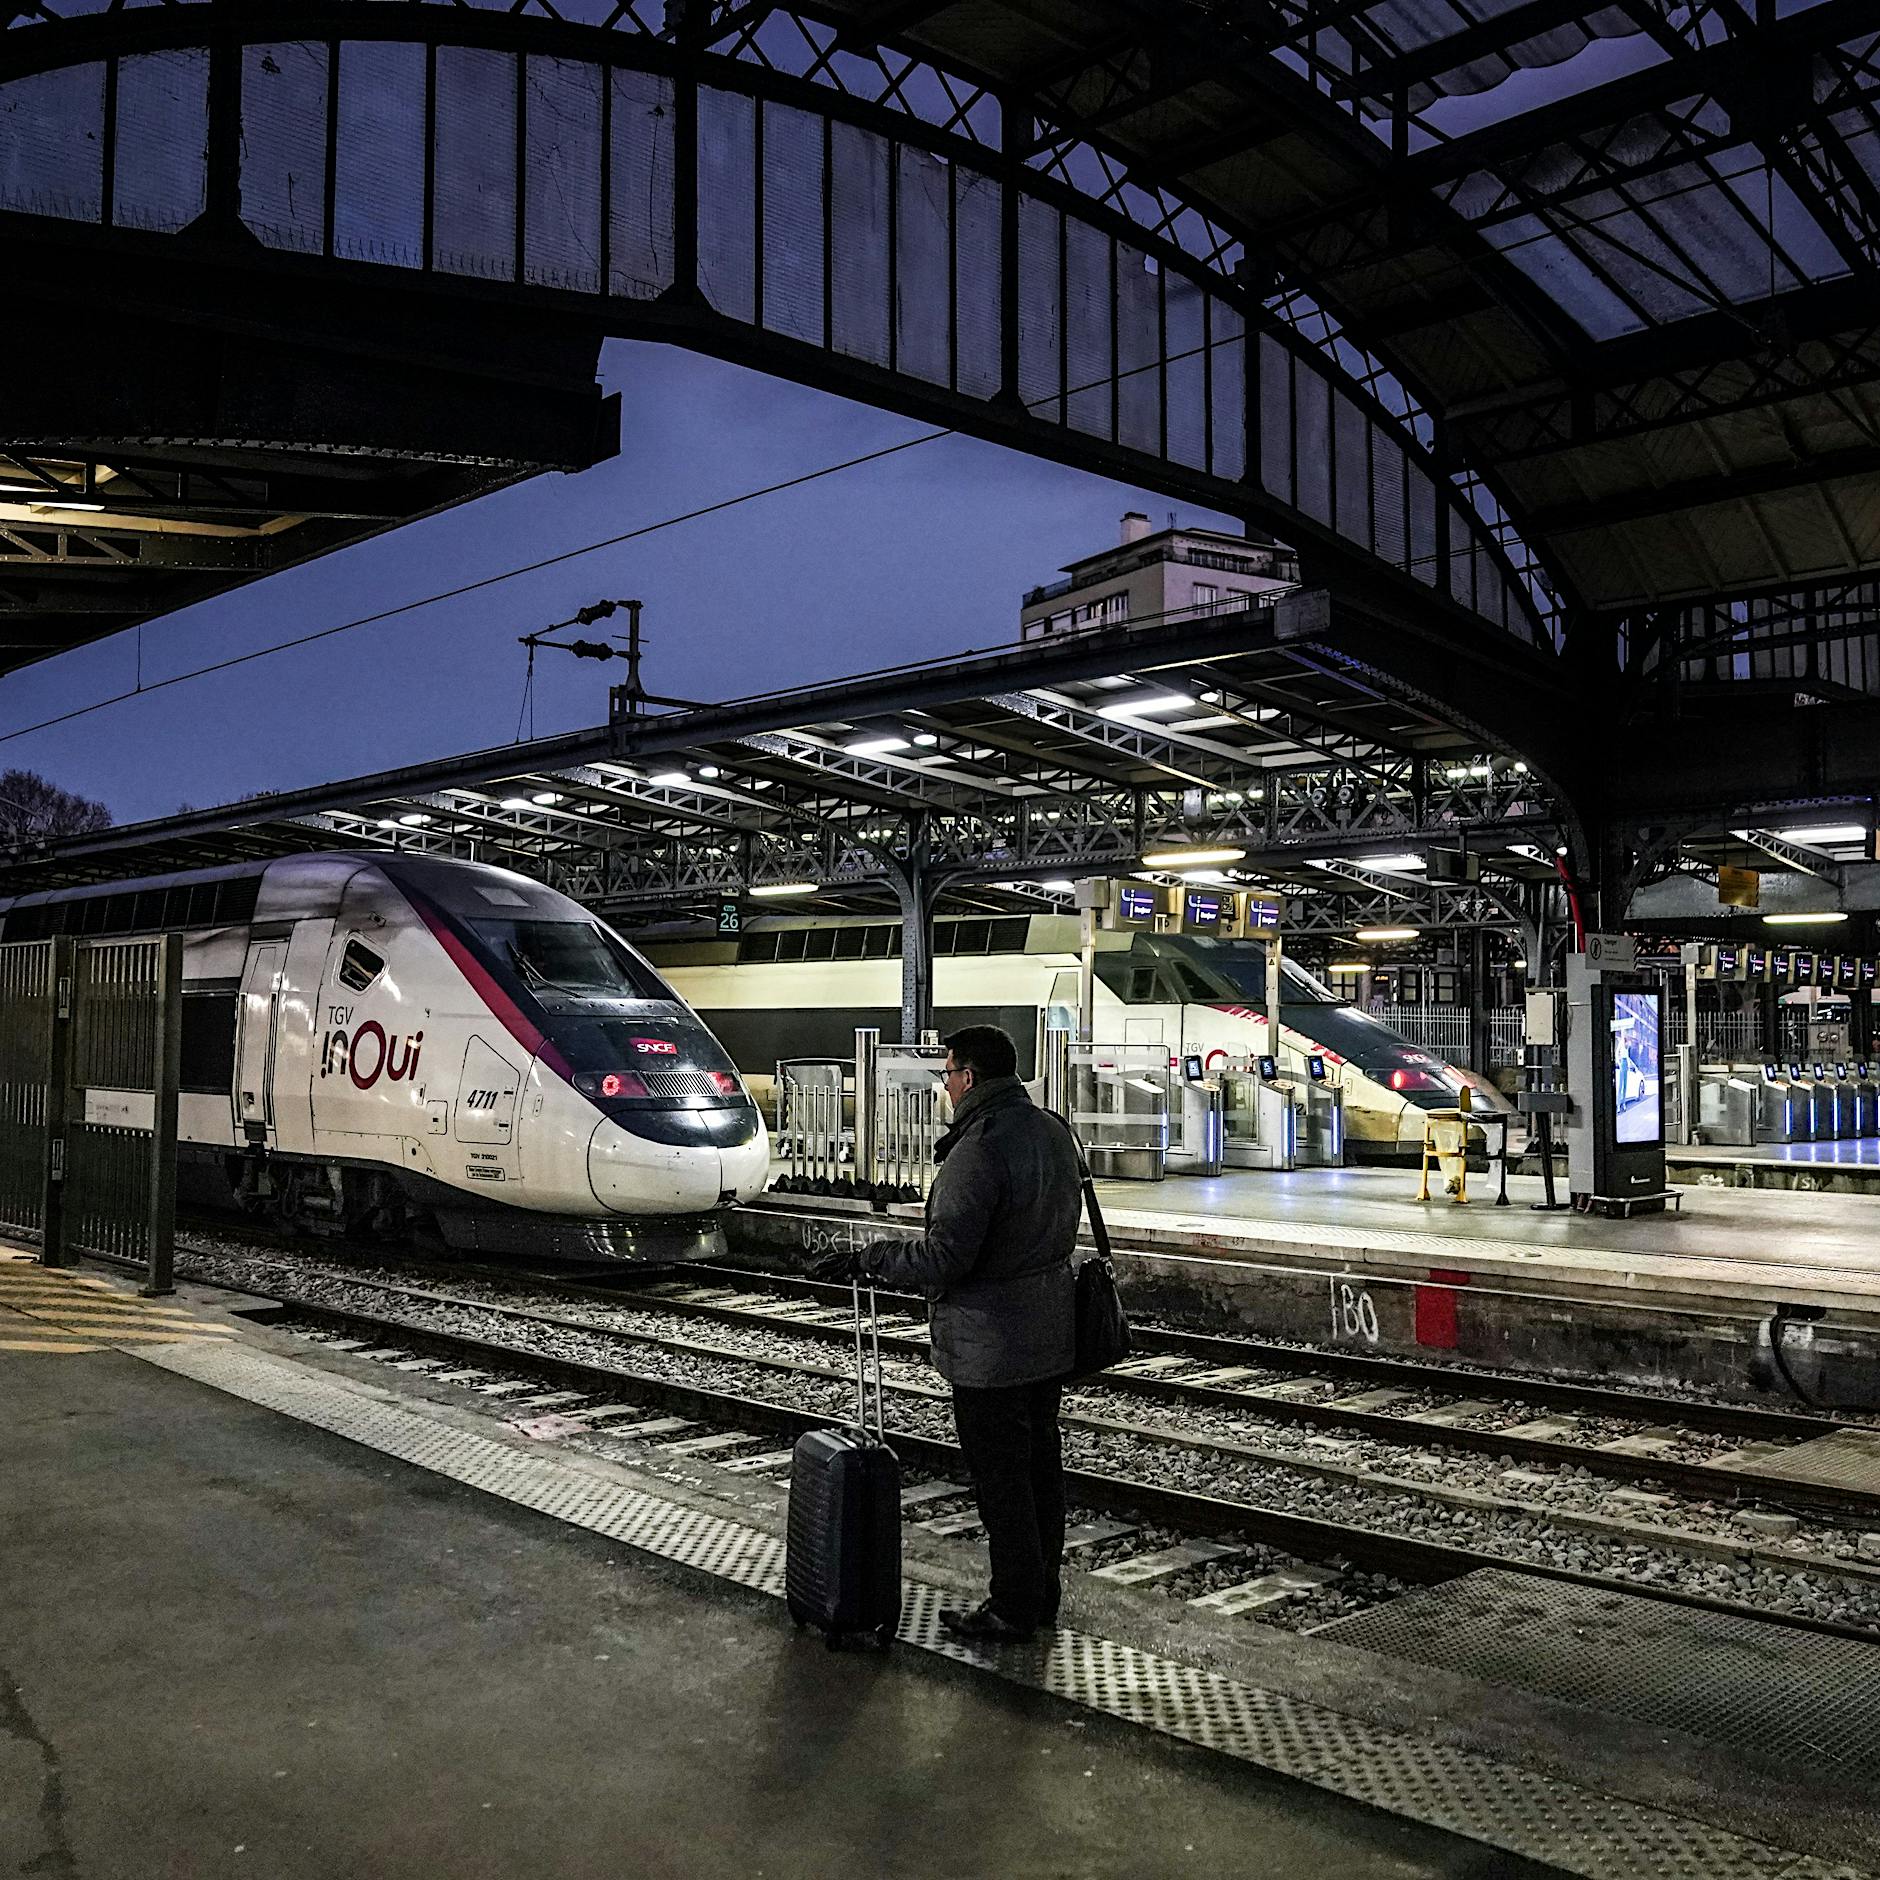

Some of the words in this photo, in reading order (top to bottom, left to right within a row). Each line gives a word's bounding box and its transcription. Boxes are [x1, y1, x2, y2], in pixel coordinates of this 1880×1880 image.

[720, 912, 739, 929] 26
[328, 1006, 354, 1025] TGV
[637, 1043, 673, 1053] SNCF
[1186, 1042, 1205, 1053] TGV
[467, 1089, 499, 1109] 4711
